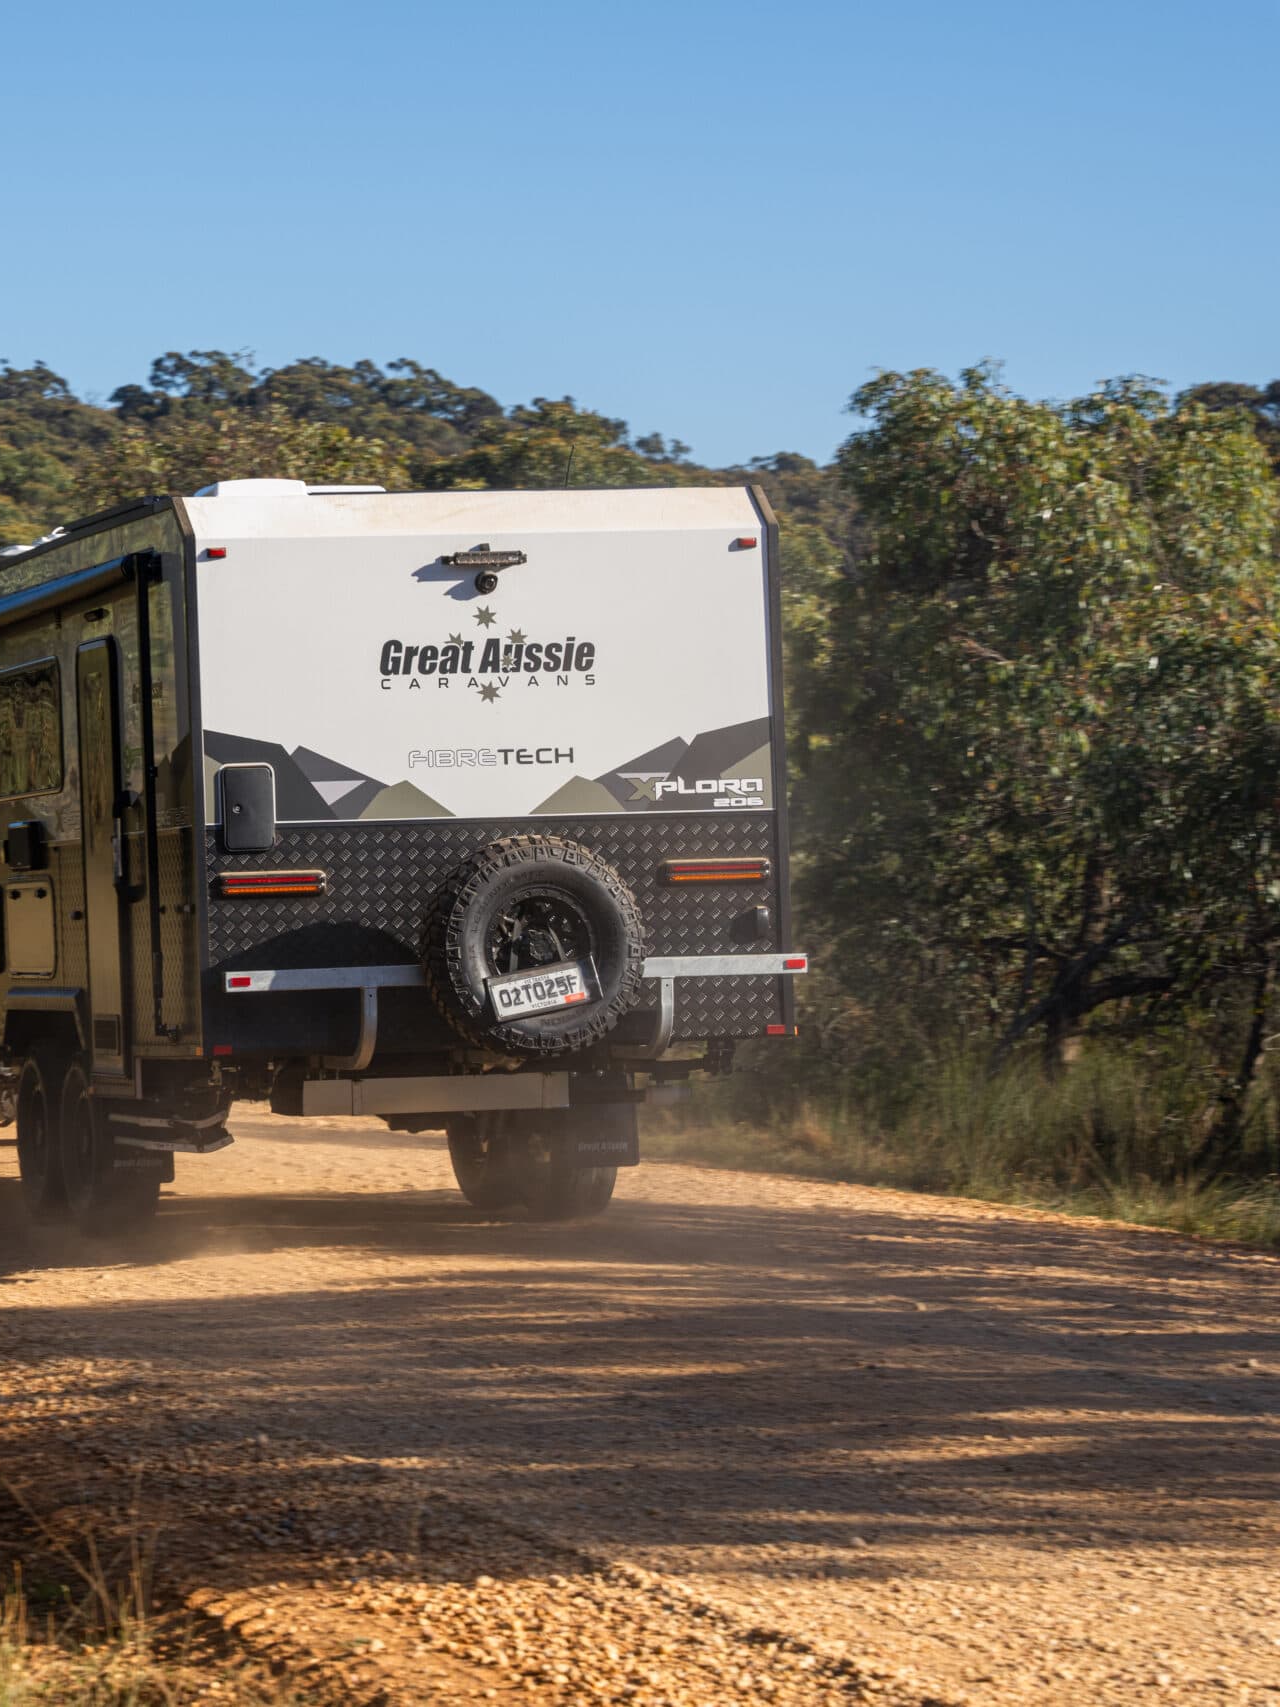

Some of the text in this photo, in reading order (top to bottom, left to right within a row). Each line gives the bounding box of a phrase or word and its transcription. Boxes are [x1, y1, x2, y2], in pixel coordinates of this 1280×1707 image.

[380, 637, 595, 676] Great Aussie
[381, 674, 596, 690] CARAVANS
[408, 747, 575, 768] FIBRETECH
[713, 797, 764, 808] 206
